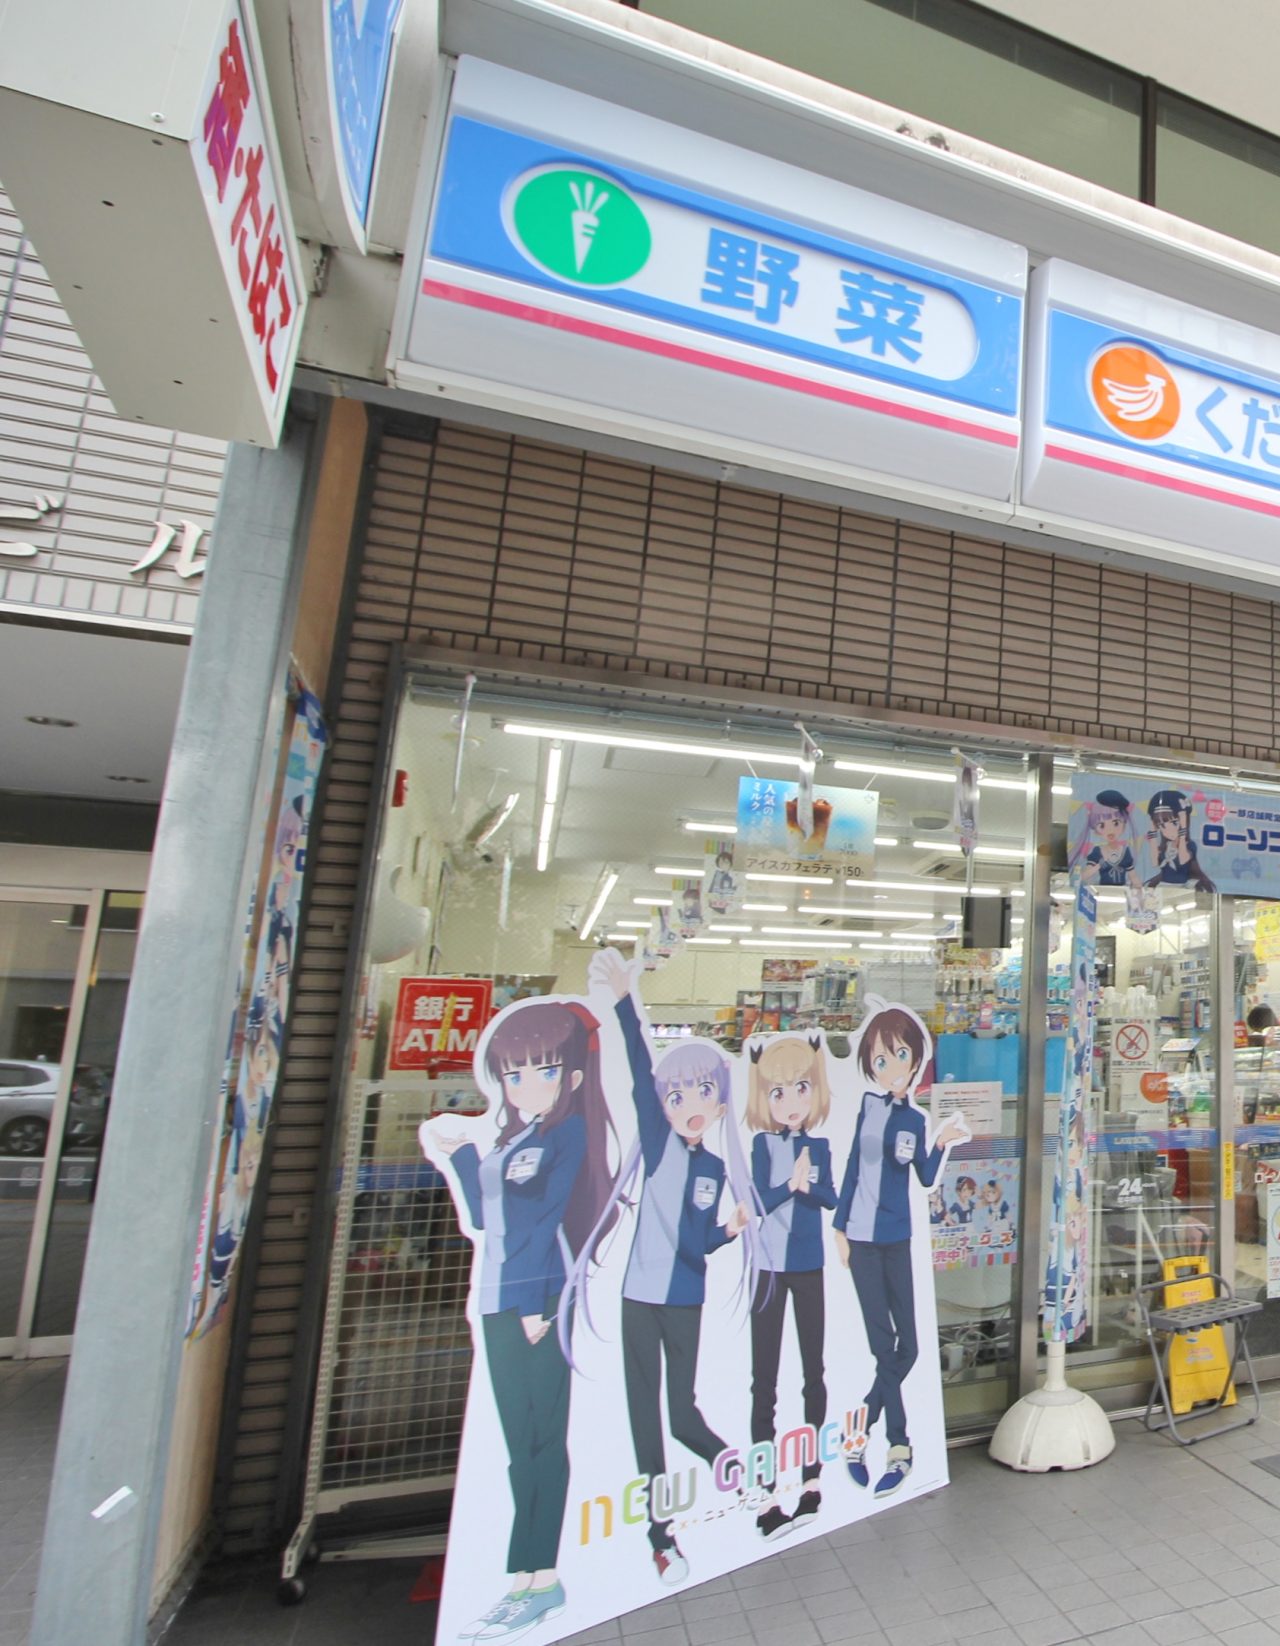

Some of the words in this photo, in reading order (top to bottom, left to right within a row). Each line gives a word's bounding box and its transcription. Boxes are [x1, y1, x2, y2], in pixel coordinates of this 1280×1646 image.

[700, 228, 925, 364] 野菜
[747, 858, 832, 874] アイスカフェラテ
[413, 996, 474, 1021] 銀行
[400, 1028, 478, 1052] ATM
[1119, 1178, 1142, 1195] 24
[580, 1467, 697, 1546] NEW
